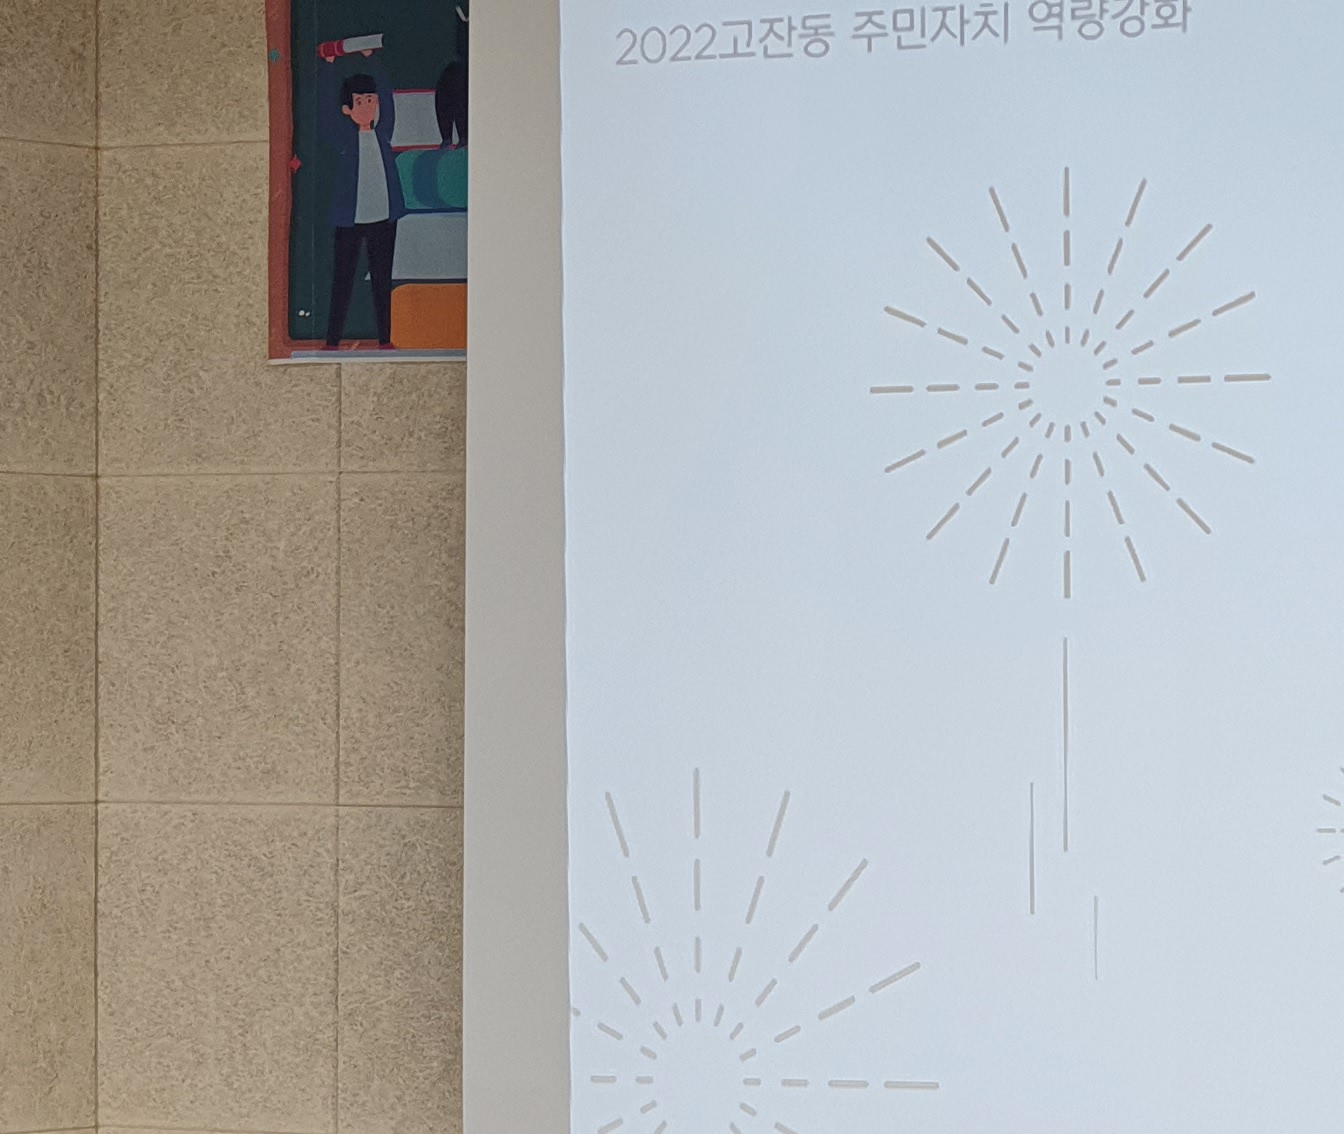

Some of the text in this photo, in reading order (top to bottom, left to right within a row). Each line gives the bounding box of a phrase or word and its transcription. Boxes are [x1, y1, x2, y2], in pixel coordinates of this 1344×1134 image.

[615, 0, 1193, 66] 2022고잔동 주민자치 역량강화
